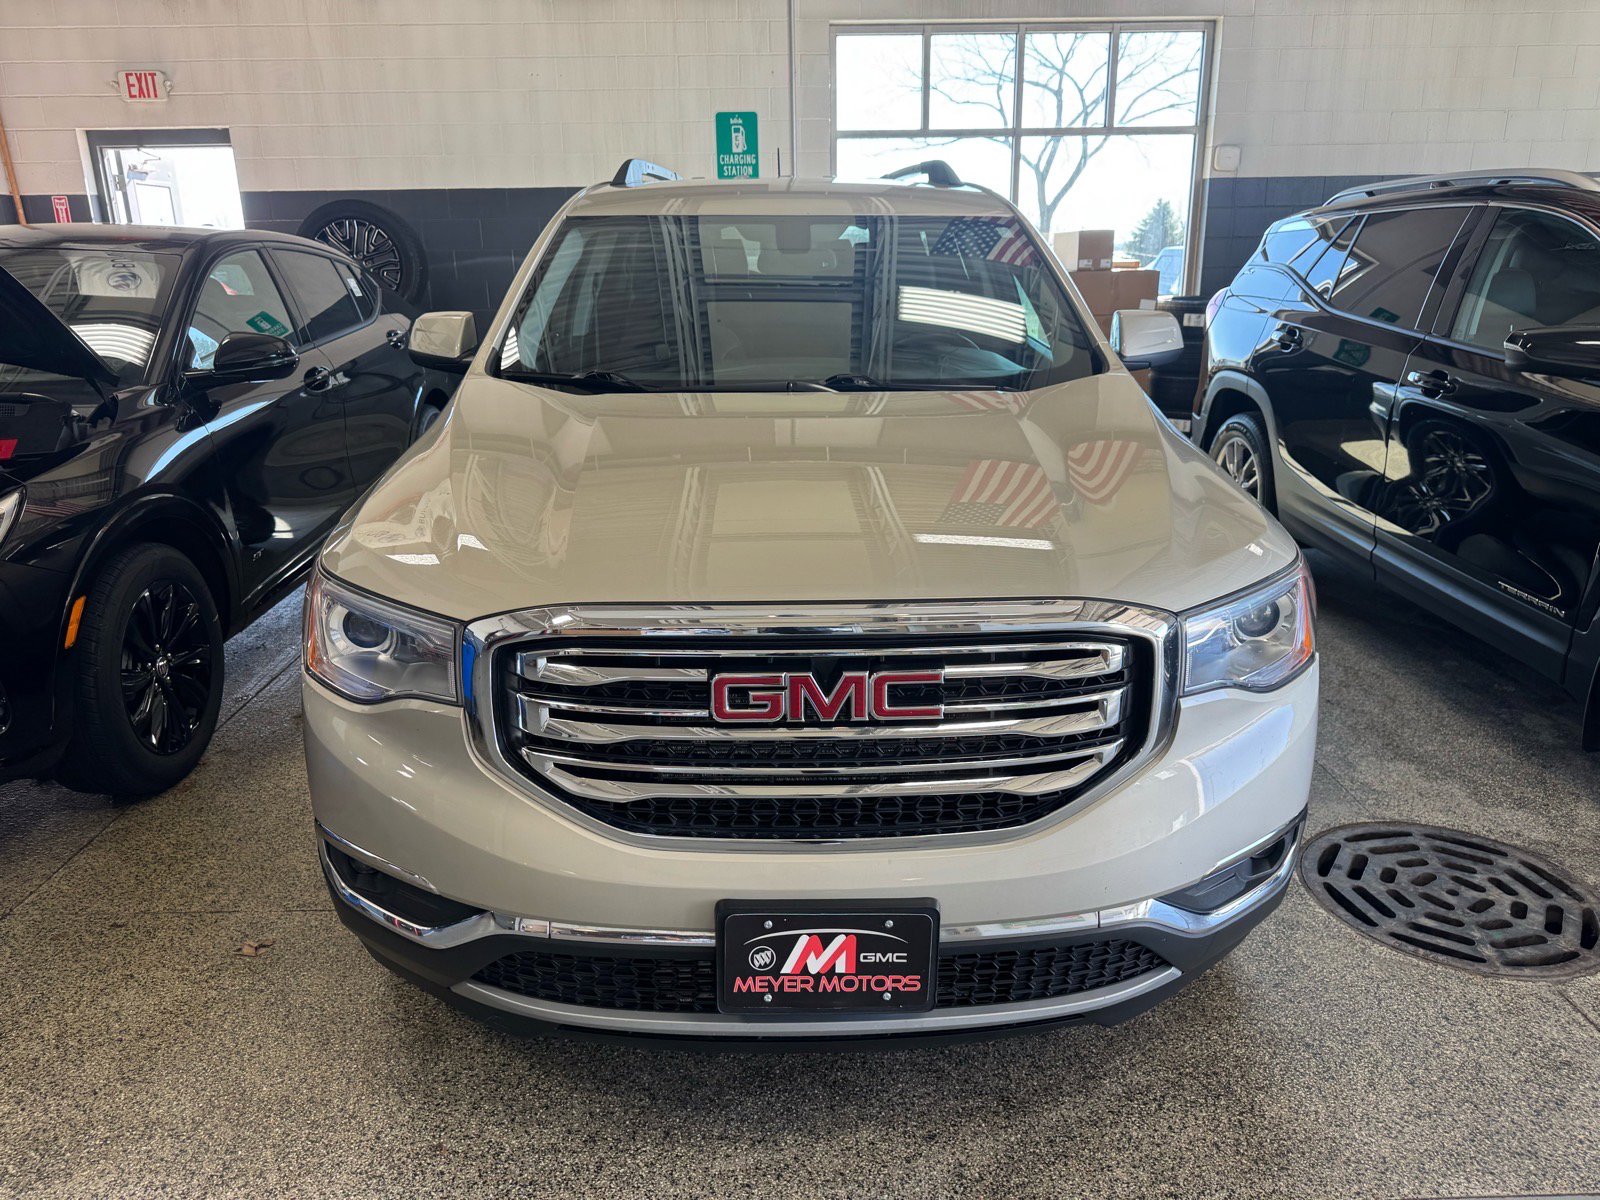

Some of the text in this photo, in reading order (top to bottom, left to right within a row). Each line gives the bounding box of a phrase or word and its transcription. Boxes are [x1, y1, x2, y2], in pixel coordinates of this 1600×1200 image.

[125, 72, 158, 99] EXIT
[719, 154, 756, 165] CHARGING
[723, 165, 753, 176] STATION
[1498, 580, 1565, 618] TERRAIN
[711, 671, 944, 723] GMC
[859, 952, 908, 963] GMC
[733, 974, 921, 993] MEYER MOTORS
